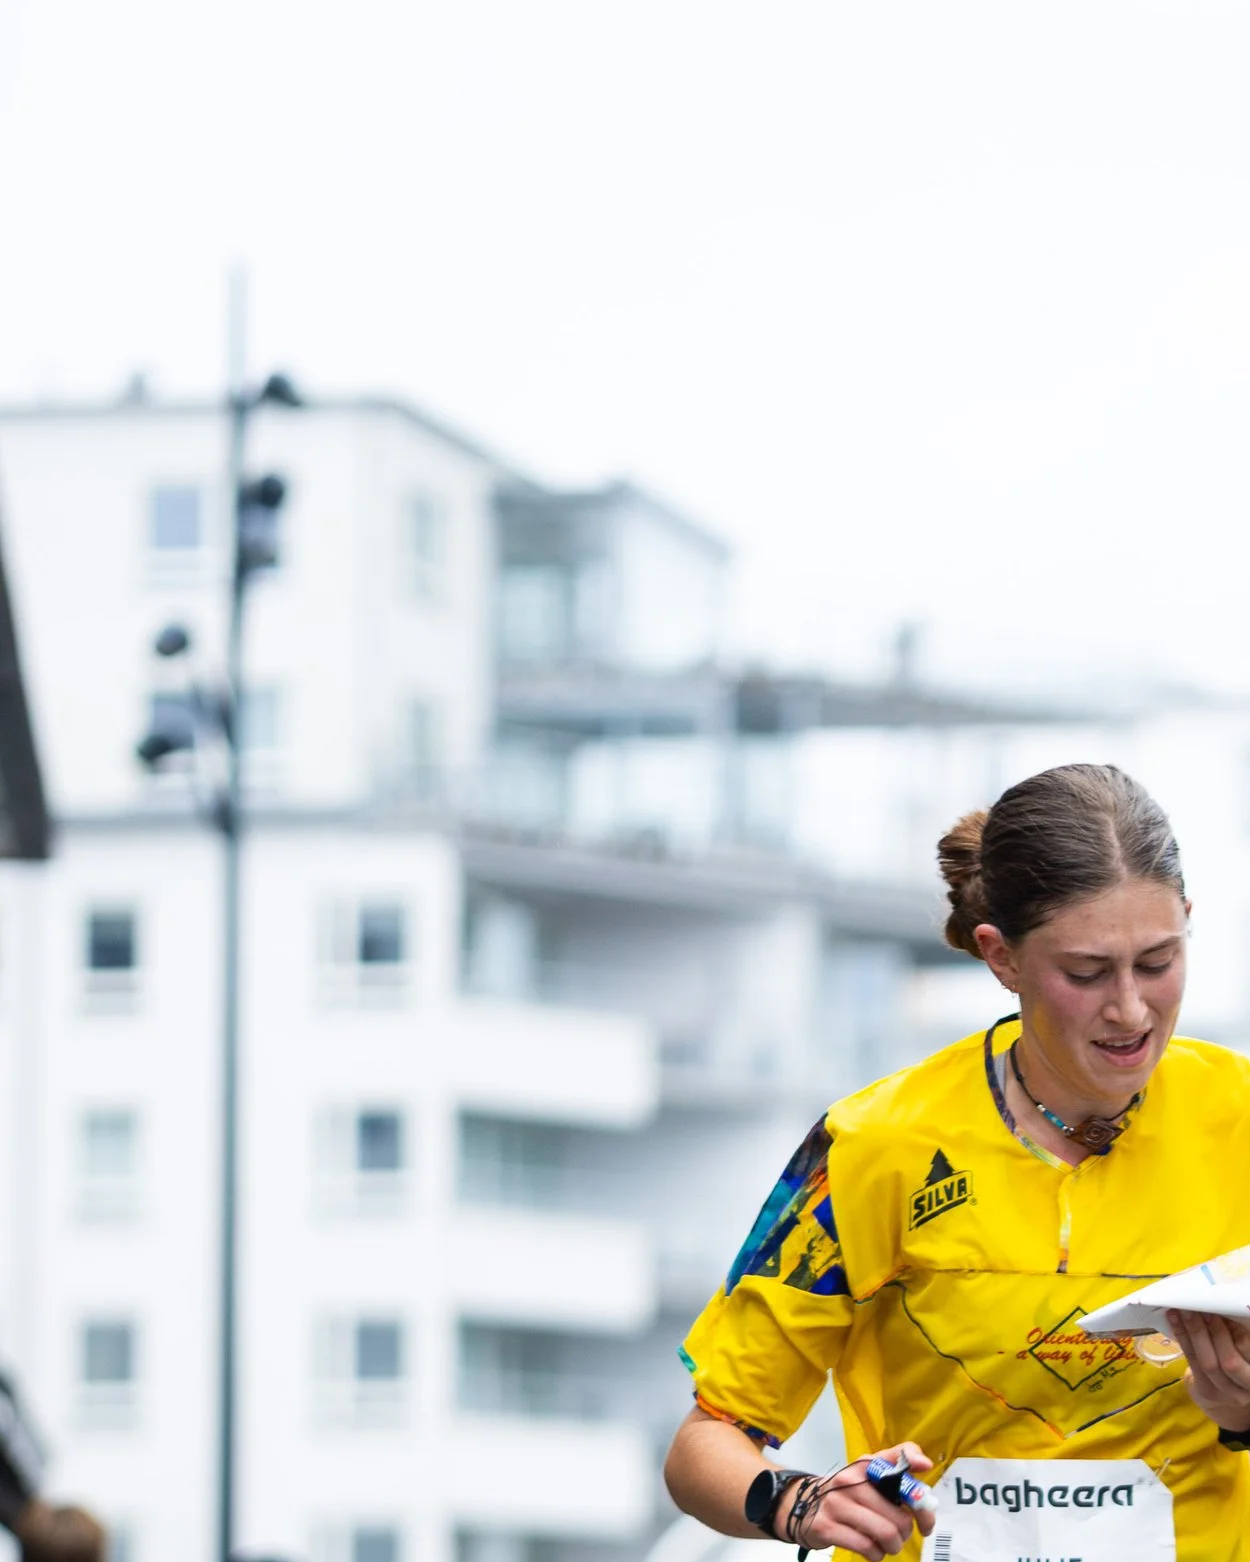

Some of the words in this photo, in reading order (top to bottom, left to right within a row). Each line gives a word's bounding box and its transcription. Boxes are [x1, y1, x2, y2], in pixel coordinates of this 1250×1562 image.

[912, 1176, 968, 1222] SILVA
[1036, 1350, 1072, 1364] way
[1080, 1345, 1098, 1366] of
[956, 1477, 1133, 1512] bagheera
